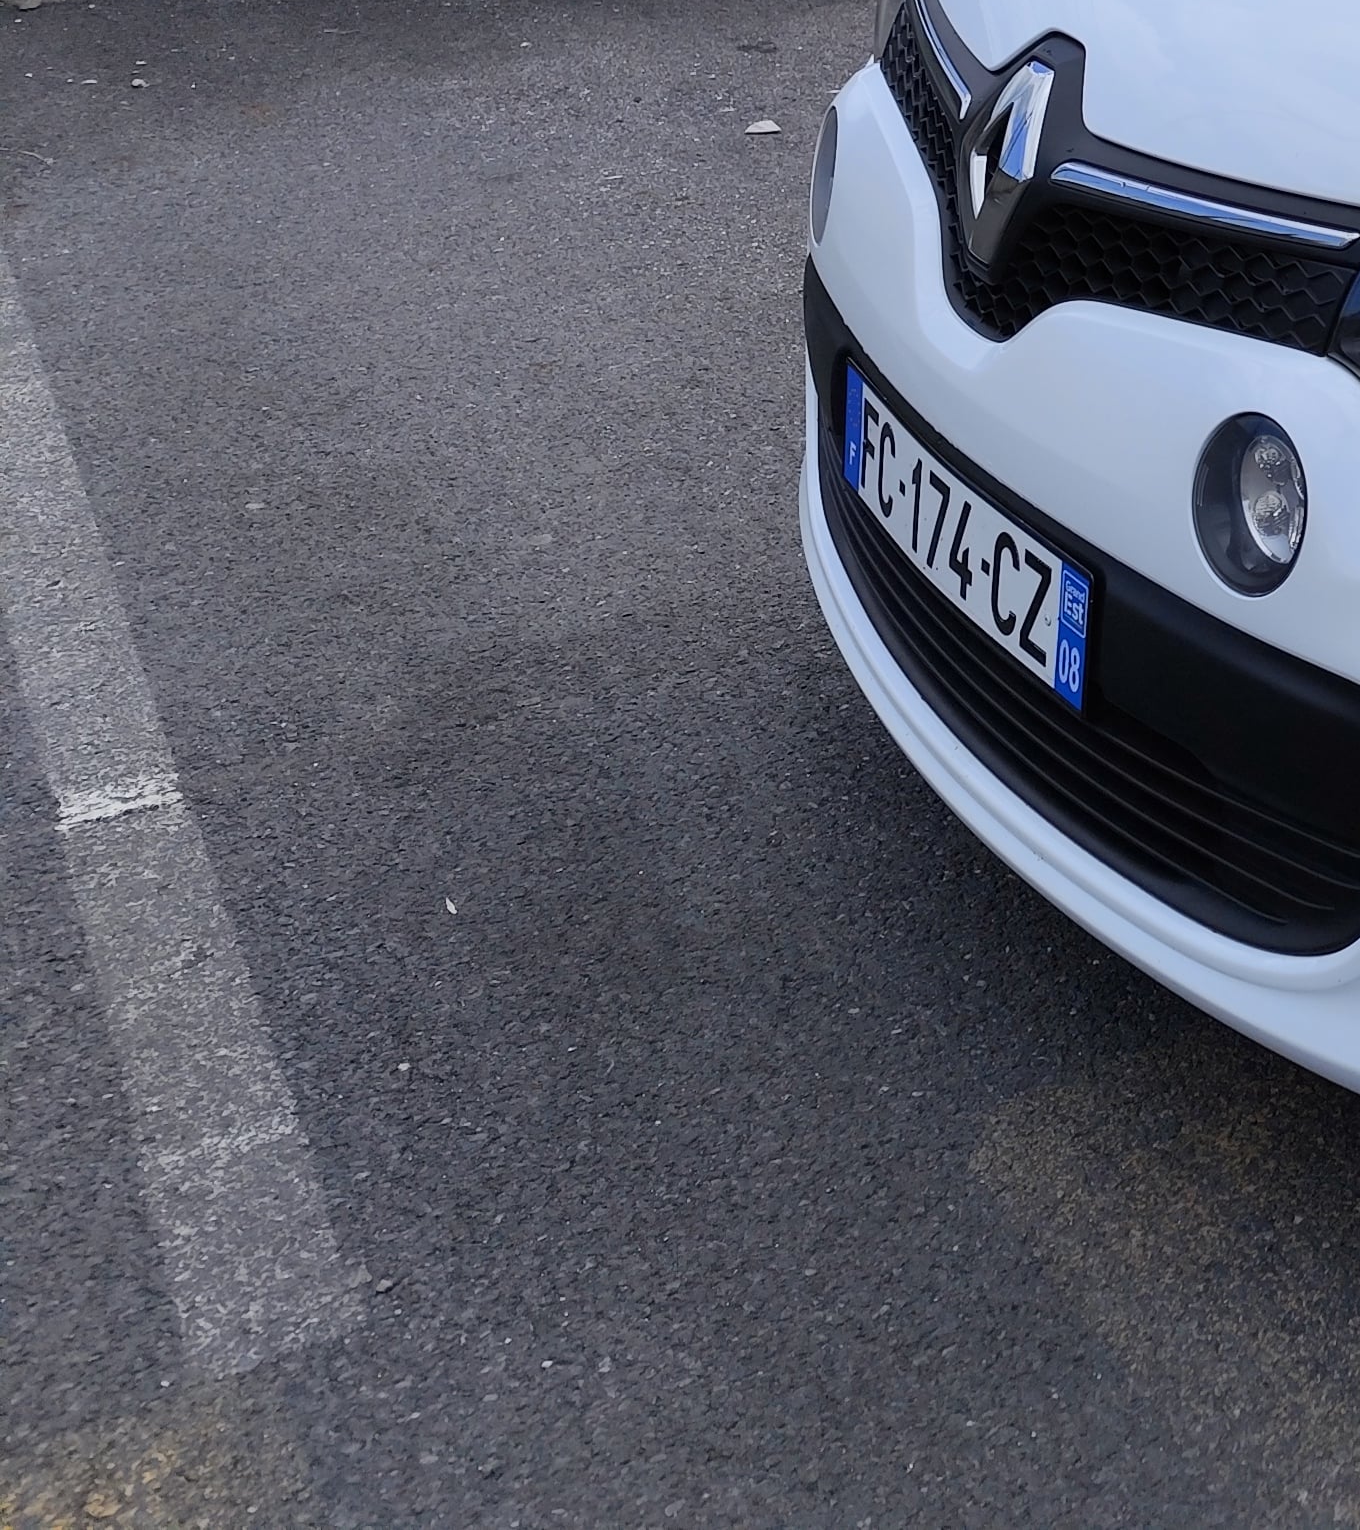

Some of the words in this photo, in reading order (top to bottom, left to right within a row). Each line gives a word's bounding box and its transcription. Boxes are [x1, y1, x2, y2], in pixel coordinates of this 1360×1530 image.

[848, 440, 857, 466] F
[861, 398, 1053, 668] FC-174-CZ
[1064, 591, 1084, 626] Est
[1065, 580, 1085, 603] Grand
[1058, 638, 1081, 693] 08
